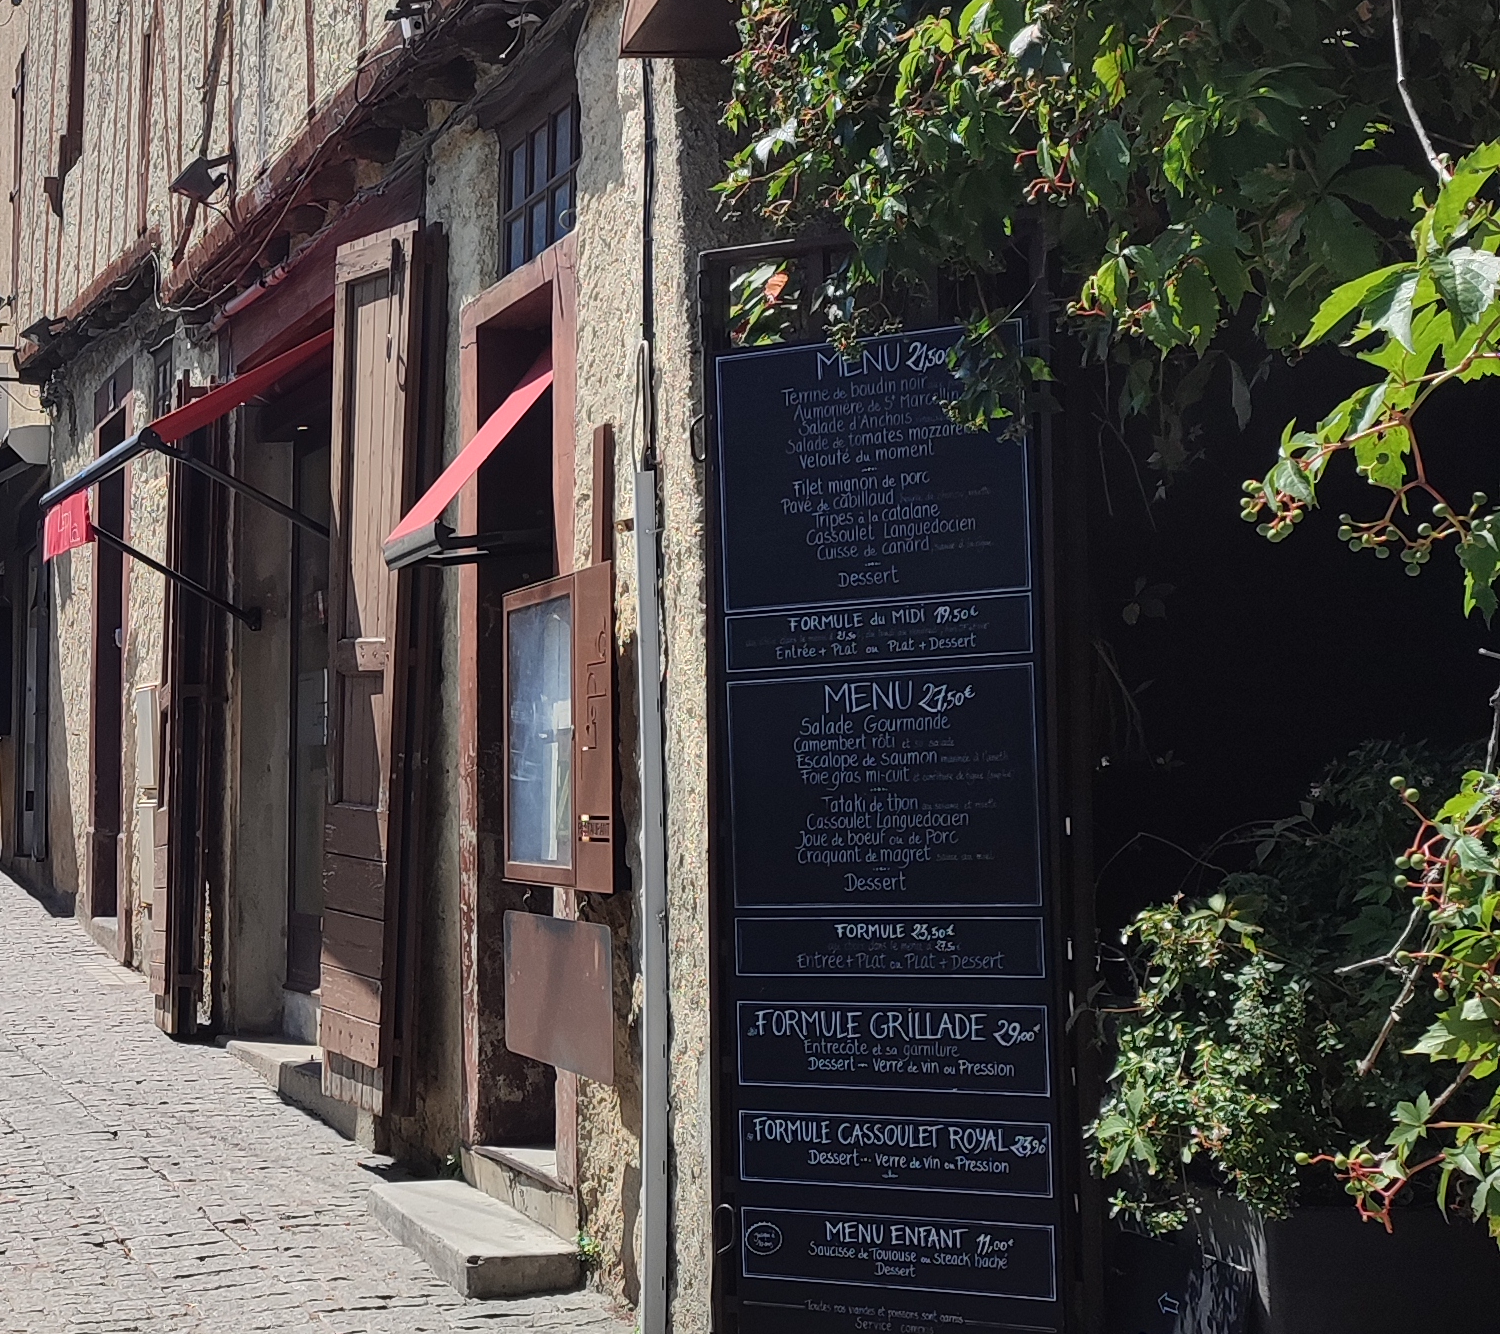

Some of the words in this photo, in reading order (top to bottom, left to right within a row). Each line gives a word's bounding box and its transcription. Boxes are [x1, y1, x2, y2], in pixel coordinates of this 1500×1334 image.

[816, 343, 901, 380] MENU
[905, 341, 952, 373] 21,50
[781, 387, 830, 406] Terrine
[833, 388, 847, 400] de
[850, 377, 896, 397] boudin
[900, 374, 928, 392] noir
[868, 400, 882, 412] de
[798, 418, 844, 437] Salade
[785, 437, 829, 455] Salade
[832, 438, 846, 451] de
[848, 429, 904, 447] tomates
[856, 449, 871, 464] du
[875, 439, 935, 461] moment
[792, 478, 824, 497] Filet
[828, 475, 878, 496] mignon
[882, 475, 896, 488] de
[900, 470, 930, 490] porc
[780, 496, 812, 515] Pavé
[817, 500, 830, 512] de
[833, 489, 894, 510] cabillaud
[812, 511, 853, 531] Tripes
[868, 509, 879, 522] la
[882, 503, 941, 522] catalane
[806, 526, 875, 546] Cassoulet
[884, 517, 976, 541] Languedocien
[817, 544, 858, 561] Cuisse
[863, 544, 877, 557] de
[838, 565, 900, 587] Dessert
[788, 613, 863, 632] FORMULE
[870, 612, 885, 626] du
[775, 644, 817, 660] Entrée
[866, 645, 879, 654] ou
[929, 633, 976, 651] Dessert
[824, 680, 913, 714] MENU
[799, 714, 854, 736] Salade
[863, 714, 951, 734] Gourmande
[793, 734, 866, 754] Camembert
[872, 733, 895, 749] rôti
[796, 752, 859, 775] Escalope
[862, 754, 877, 766] de
[800, 768, 829, 786] Foie
[828, 769, 861, 791] gras
[866, 766, 910, 784] mi-cuit
[821, 793, 866, 813] Tataki
[869, 795, 883, 812] de
[887, 793, 919, 815] thon
[807, 813, 872, 830] Cassoulet
[876, 811, 969, 832] Languedocien
[795, 830, 828, 850] Joue
[831, 833, 845, 846] de
[848, 829, 886, 846] boeuf
[889, 836, 904, 846] ou
[908, 832, 922, 845] de
[797, 848, 861, 867] Craquant
[865, 849, 878, 862] de
[880, 846, 931, 868] magret
[844, 872, 907, 892] Dessert
[834, 923, 905, 940] FORMULE
[796, 952, 844, 970] Entrée
[889, 960, 903, 970] ou
[951, 951, 1006, 970] Dessert
[754, 1008, 863, 1042] FORMULE
[870, 1008, 988, 1041] GRILLADE
[804, 1038, 869, 1055] Entrecôte
[872, 1044, 882, 1056] et
[886, 1045, 898, 1056] sa
[807, 1056, 856, 1072] Dessert
[907, 1061, 919, 1073] de
[943, 1064, 956, 1075] ou
[959, 1060, 1015, 1078] Pression
[753, 1117, 832, 1145] FORMULE
[838, 1122, 944, 1149] CASSOULET
[949, 1126, 1010, 1154] ROYAL
[807, 1148, 860, 1168] Dessert
[875, 1152, 907, 1168] Verre
[910, 1157, 922, 1169] de
[944, 1160, 956, 1170] ou
[955, 1154, 1010, 1174] Pression
[824, 1221, 884, 1245] MENU
[889, 1223, 968, 1249] ENFANT
[808, 1240, 856, 1260] Saucisse
[857, 1247, 869, 1260] de
[871, 1247, 917, 1263] Toulouse
[974, 1252, 1009, 1270] haché
[874, 1262, 916, 1278] Dessert
[805, 1299, 832, 1313] Toutes
[878, 1306, 886, 1317] et
[855, 1316, 892, 1332] Service
